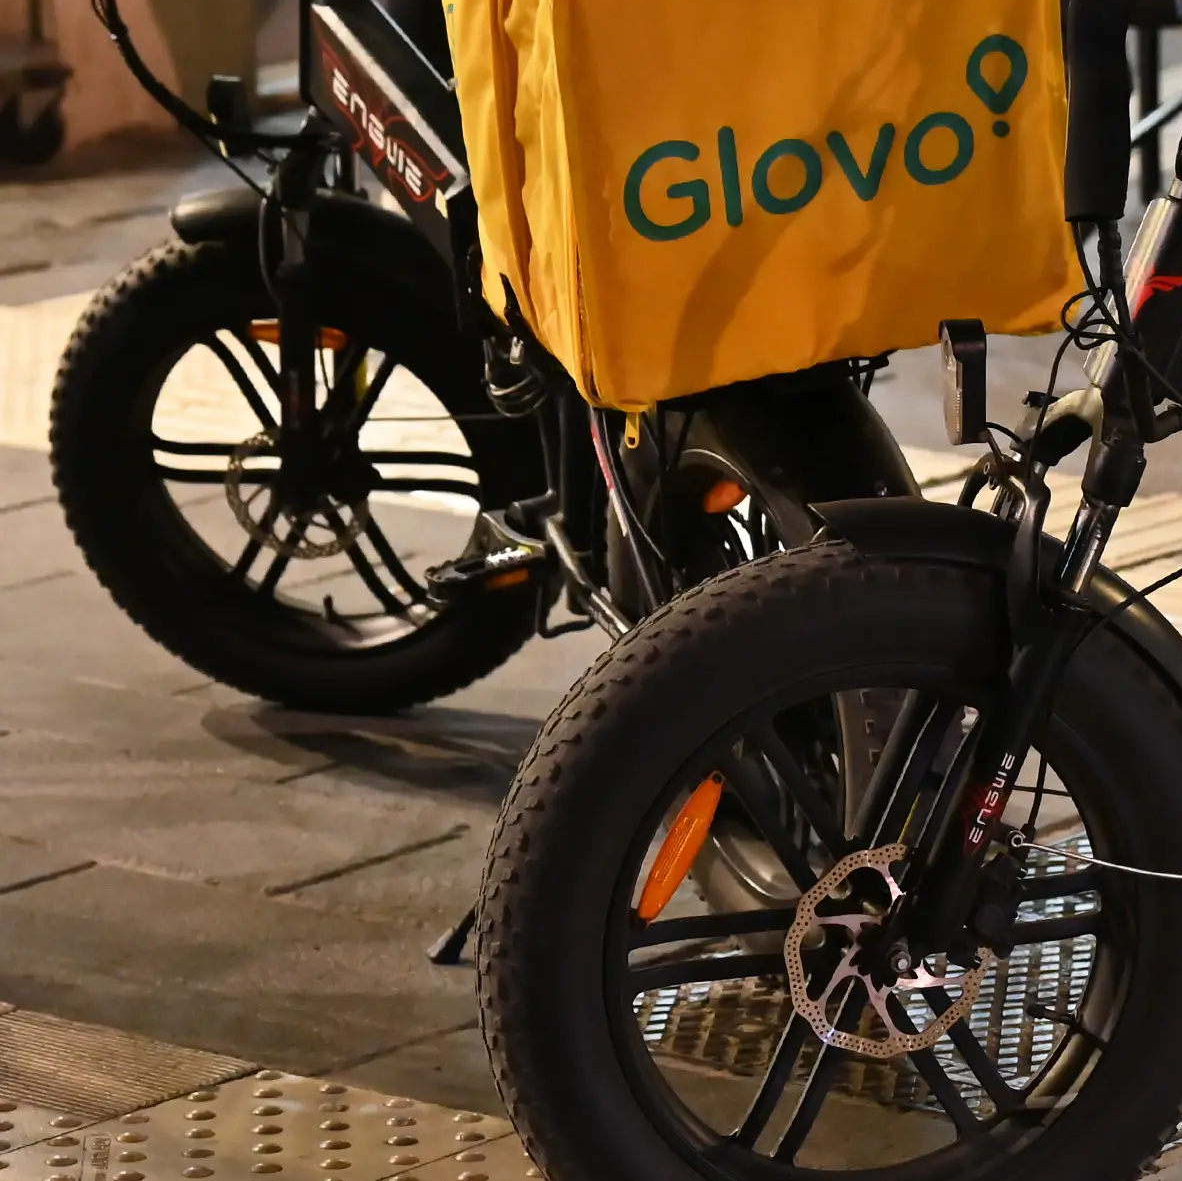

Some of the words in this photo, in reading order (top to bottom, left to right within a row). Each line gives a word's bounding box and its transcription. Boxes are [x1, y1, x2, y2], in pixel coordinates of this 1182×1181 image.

[332, 68, 423, 196] ENGWE
[624, 111, 974, 242] Glovo
[968, 752, 1016, 844] ENGWE
